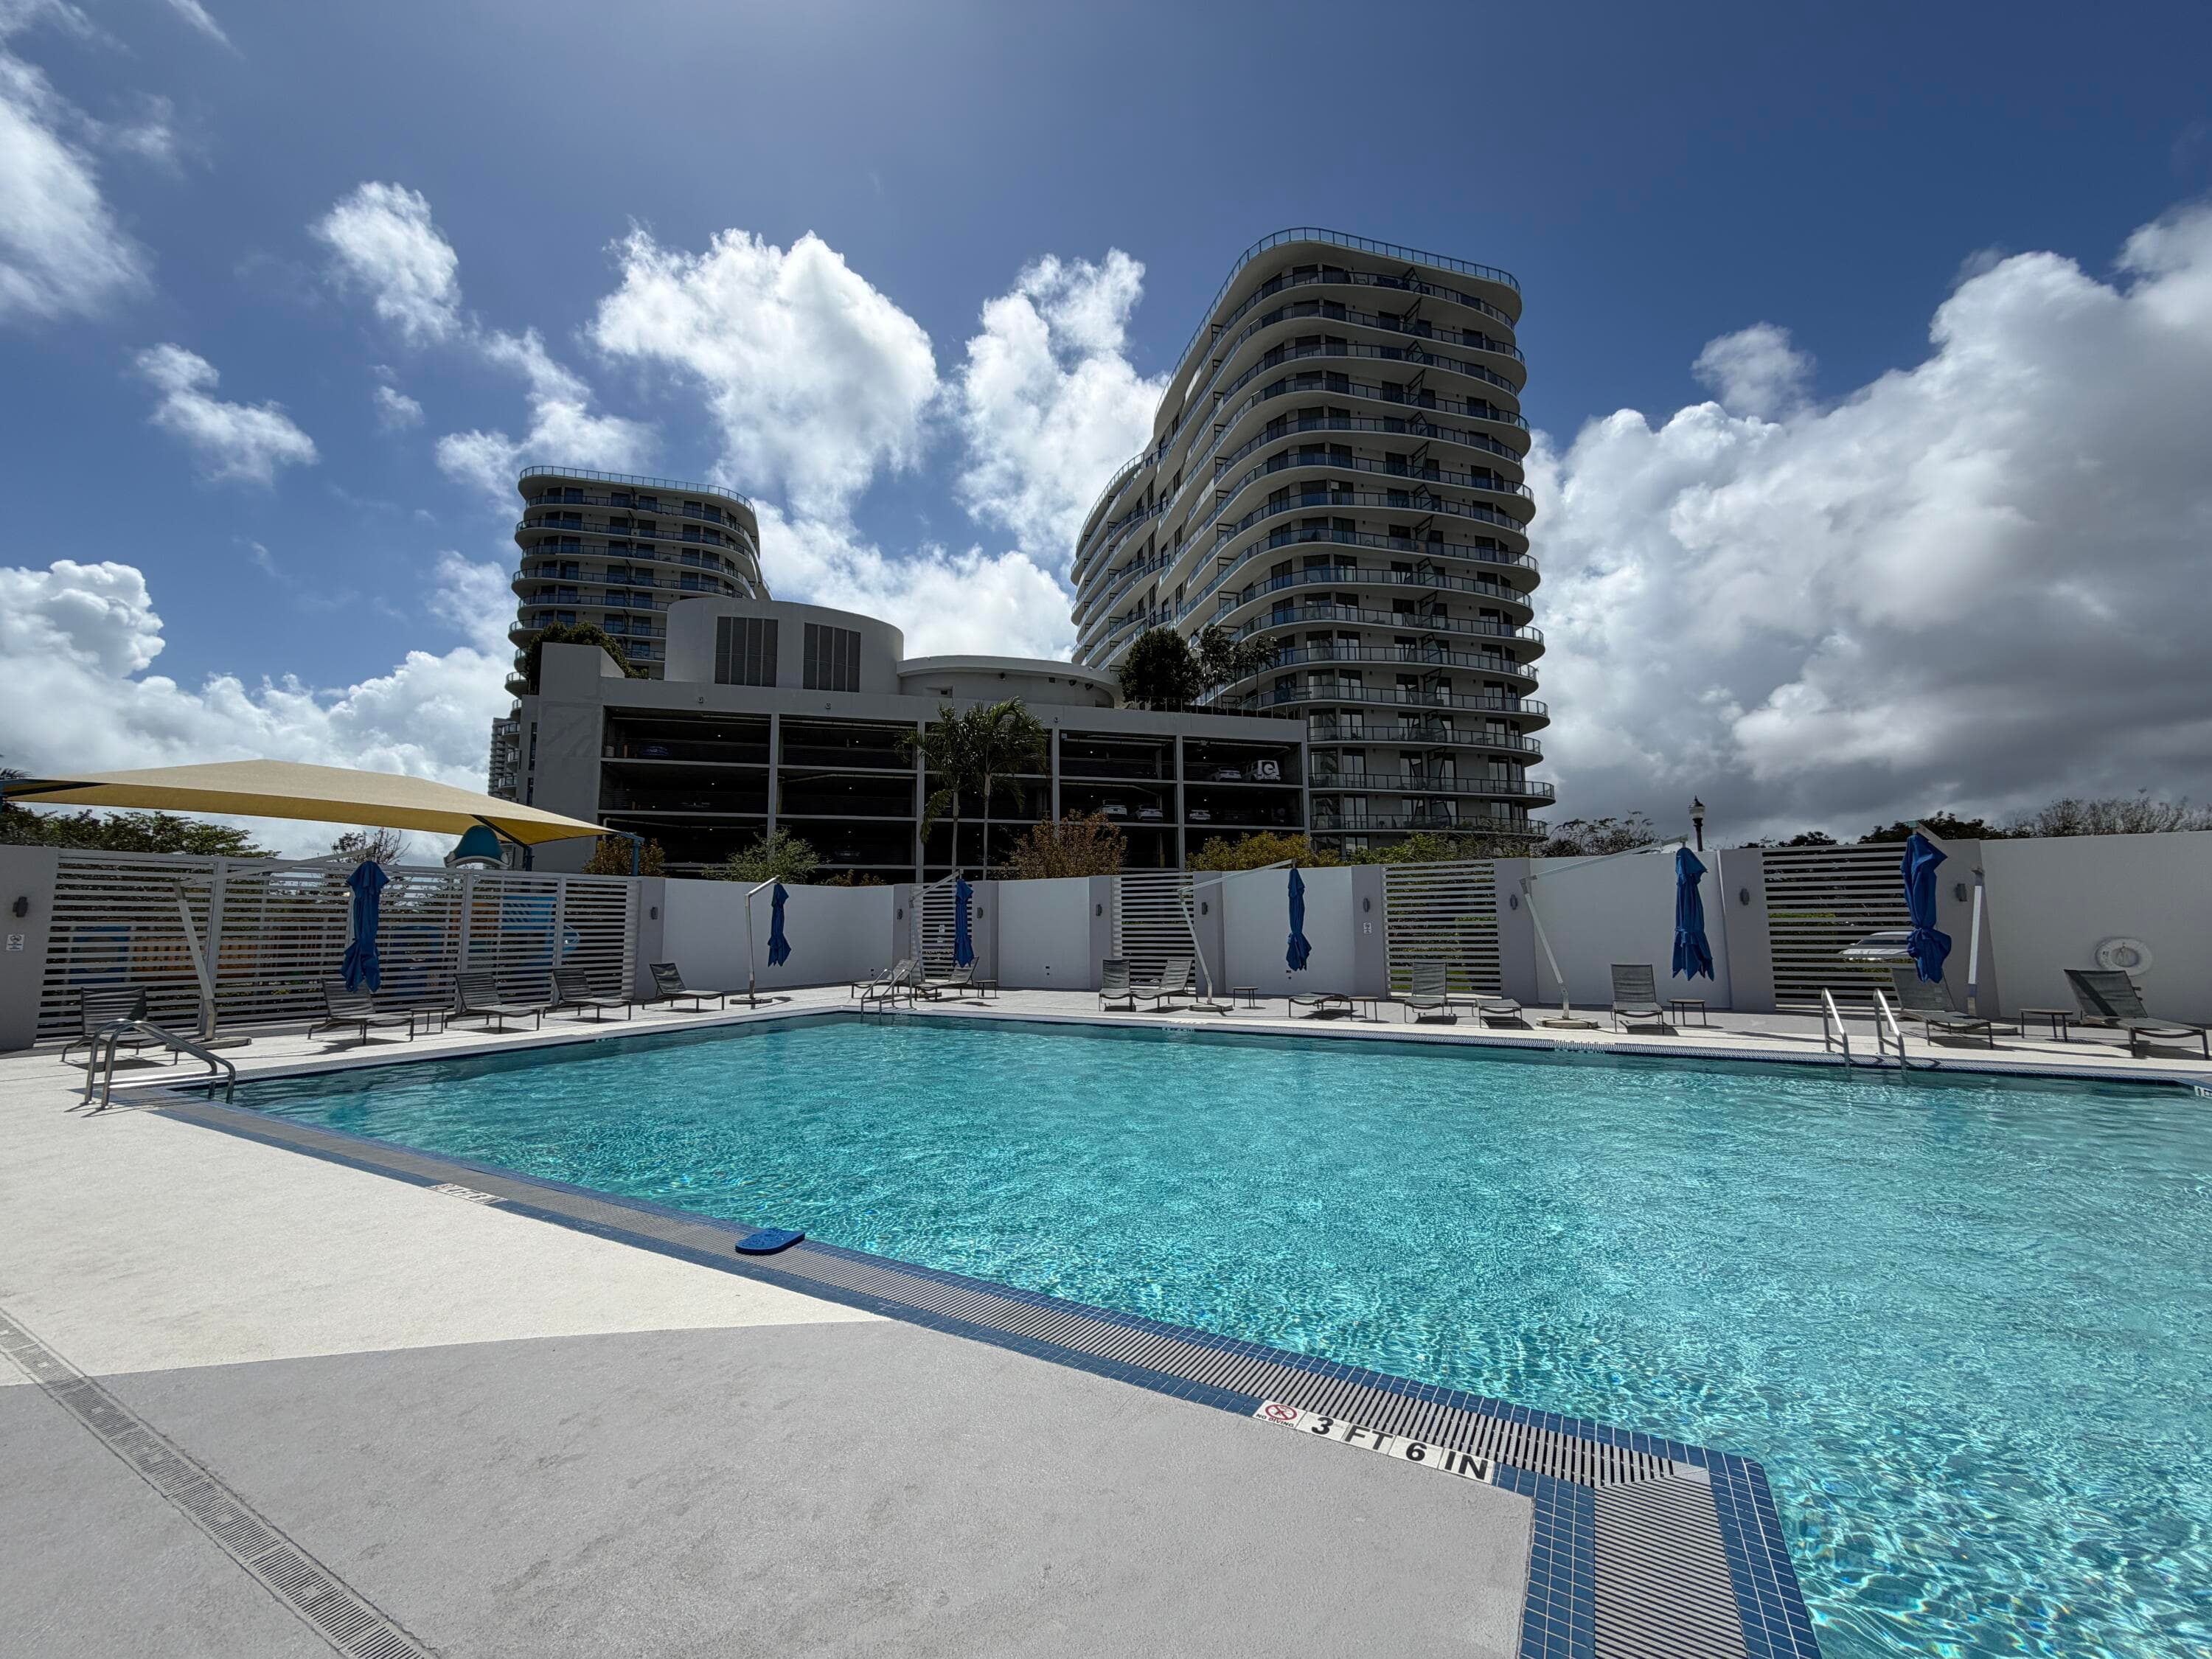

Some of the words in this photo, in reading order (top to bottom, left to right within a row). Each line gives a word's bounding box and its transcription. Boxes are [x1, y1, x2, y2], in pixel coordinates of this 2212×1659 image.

[1268, 1417, 1295, 1427] DIVING
[1311, 1416, 1334, 1435] 3
[1344, 1425, 1394, 1450] FT
[1405, 1442, 1427, 1461] 6
[1444, 1451, 1488, 1480] IN
